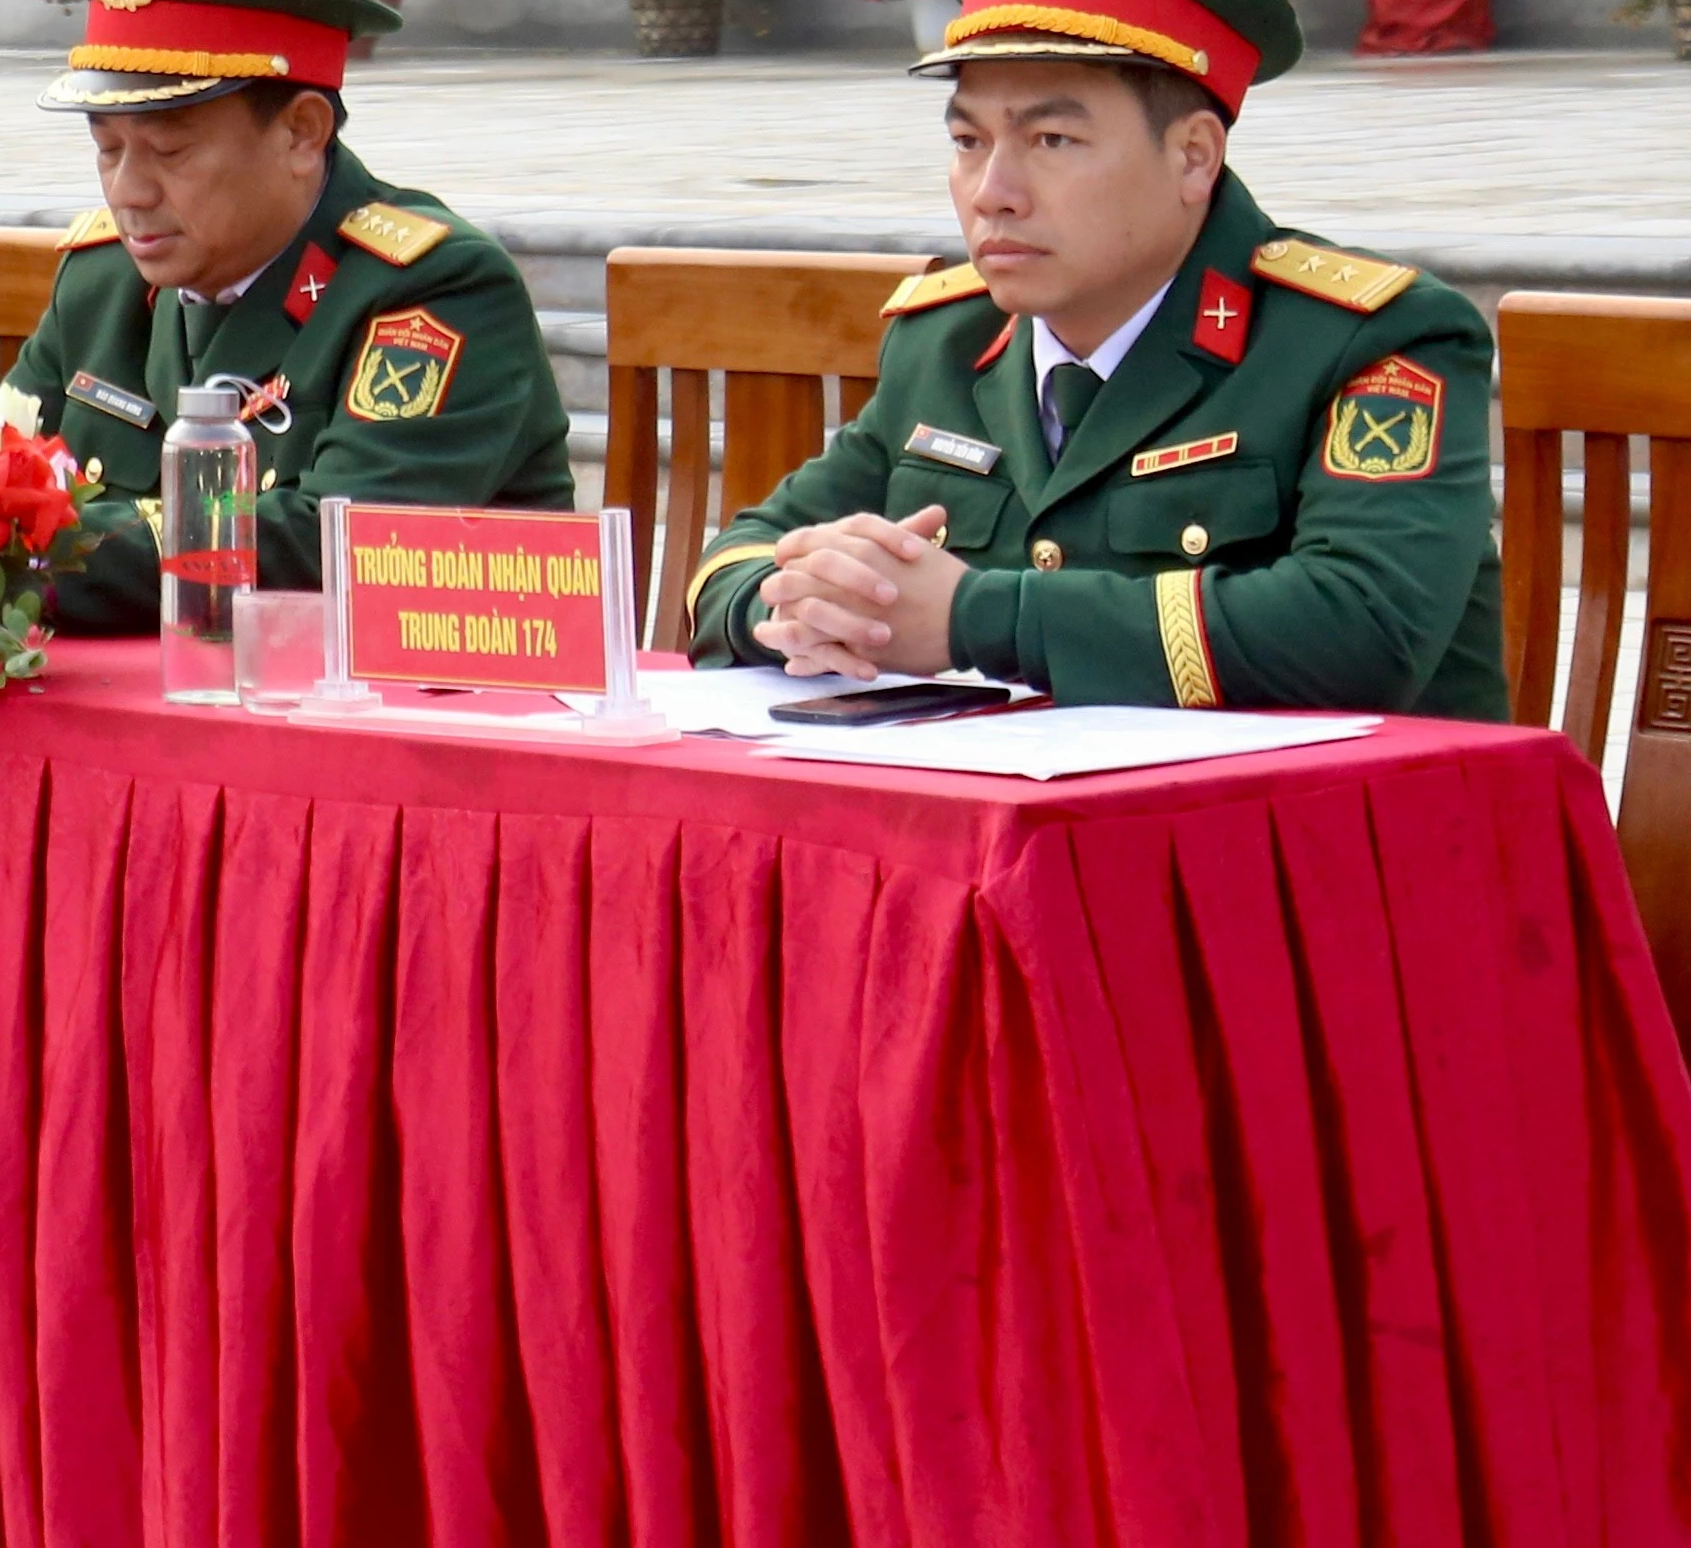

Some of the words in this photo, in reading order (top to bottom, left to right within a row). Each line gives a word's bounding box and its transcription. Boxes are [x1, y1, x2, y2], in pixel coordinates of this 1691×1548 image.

[354, 532, 427, 587] TRƯỞNG
[432, 541, 483, 590] ĐOÀN
[488, 545, 541, 602] NHẬN
[546, 549, 600, 599] QUÂN
[398, 611, 460, 652] TRUNG
[465, 608, 517, 656] ĐOÀN
[522, 619, 557, 658] 174
